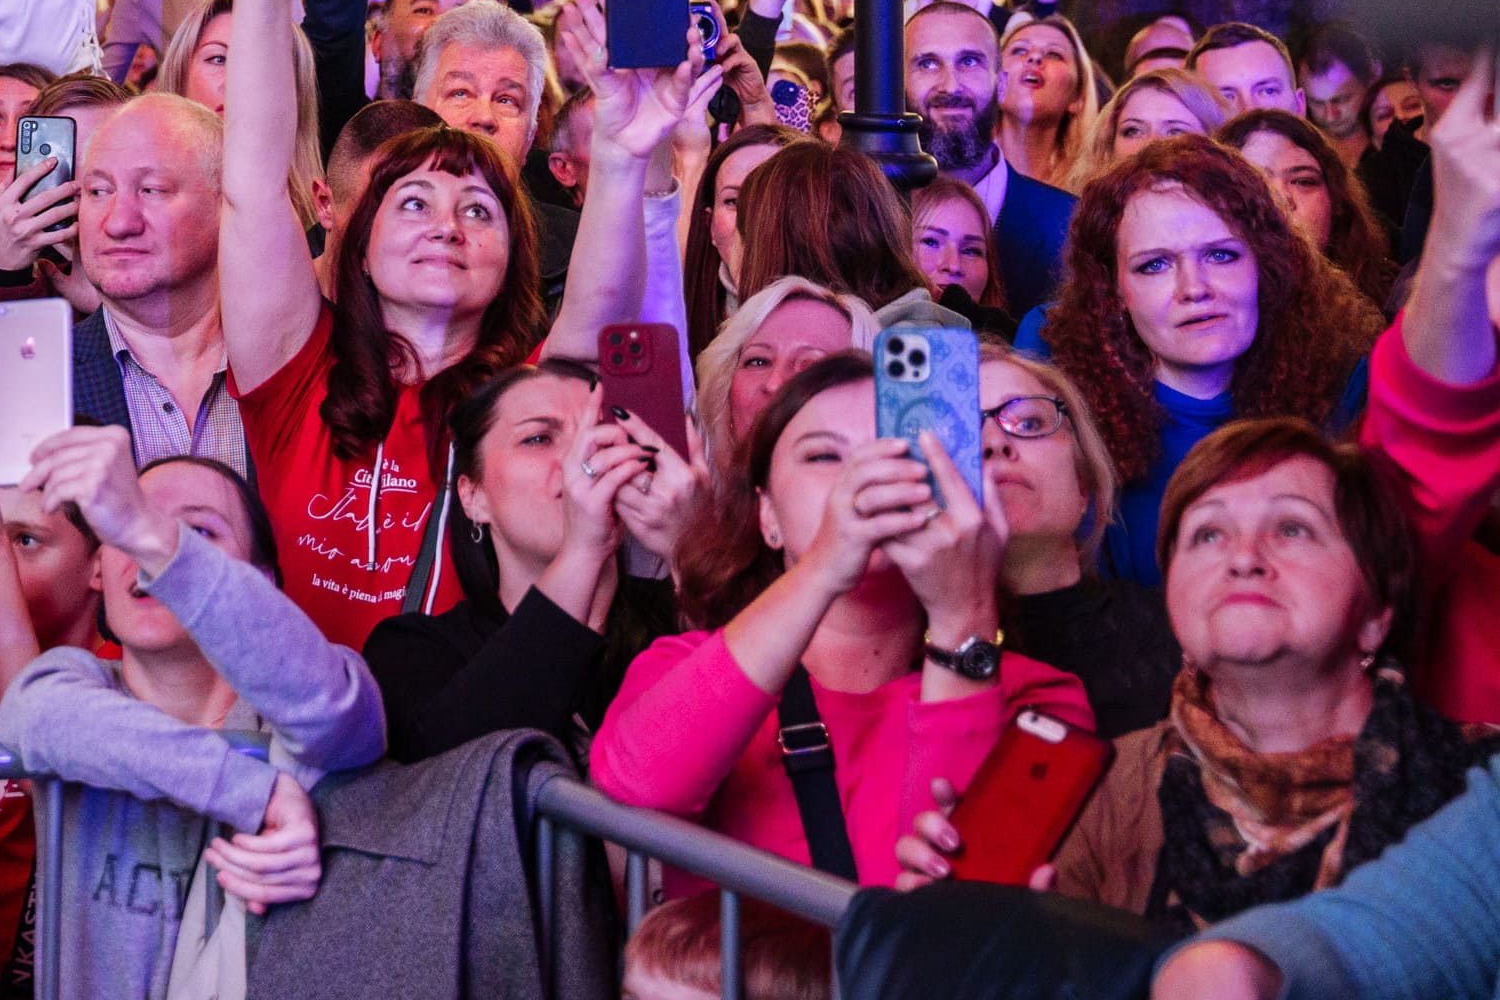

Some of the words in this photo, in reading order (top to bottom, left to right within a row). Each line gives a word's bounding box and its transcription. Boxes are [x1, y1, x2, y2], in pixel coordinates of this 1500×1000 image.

[390, 459, 400, 473] la
[381, 473, 417, 489] ilano
[297, 533, 344, 560] mio
[311, 573, 321, 586] la
[323, 578, 340, 593] vita
[341, 584, 348, 595] è
[348, 589, 377, 604] piena
